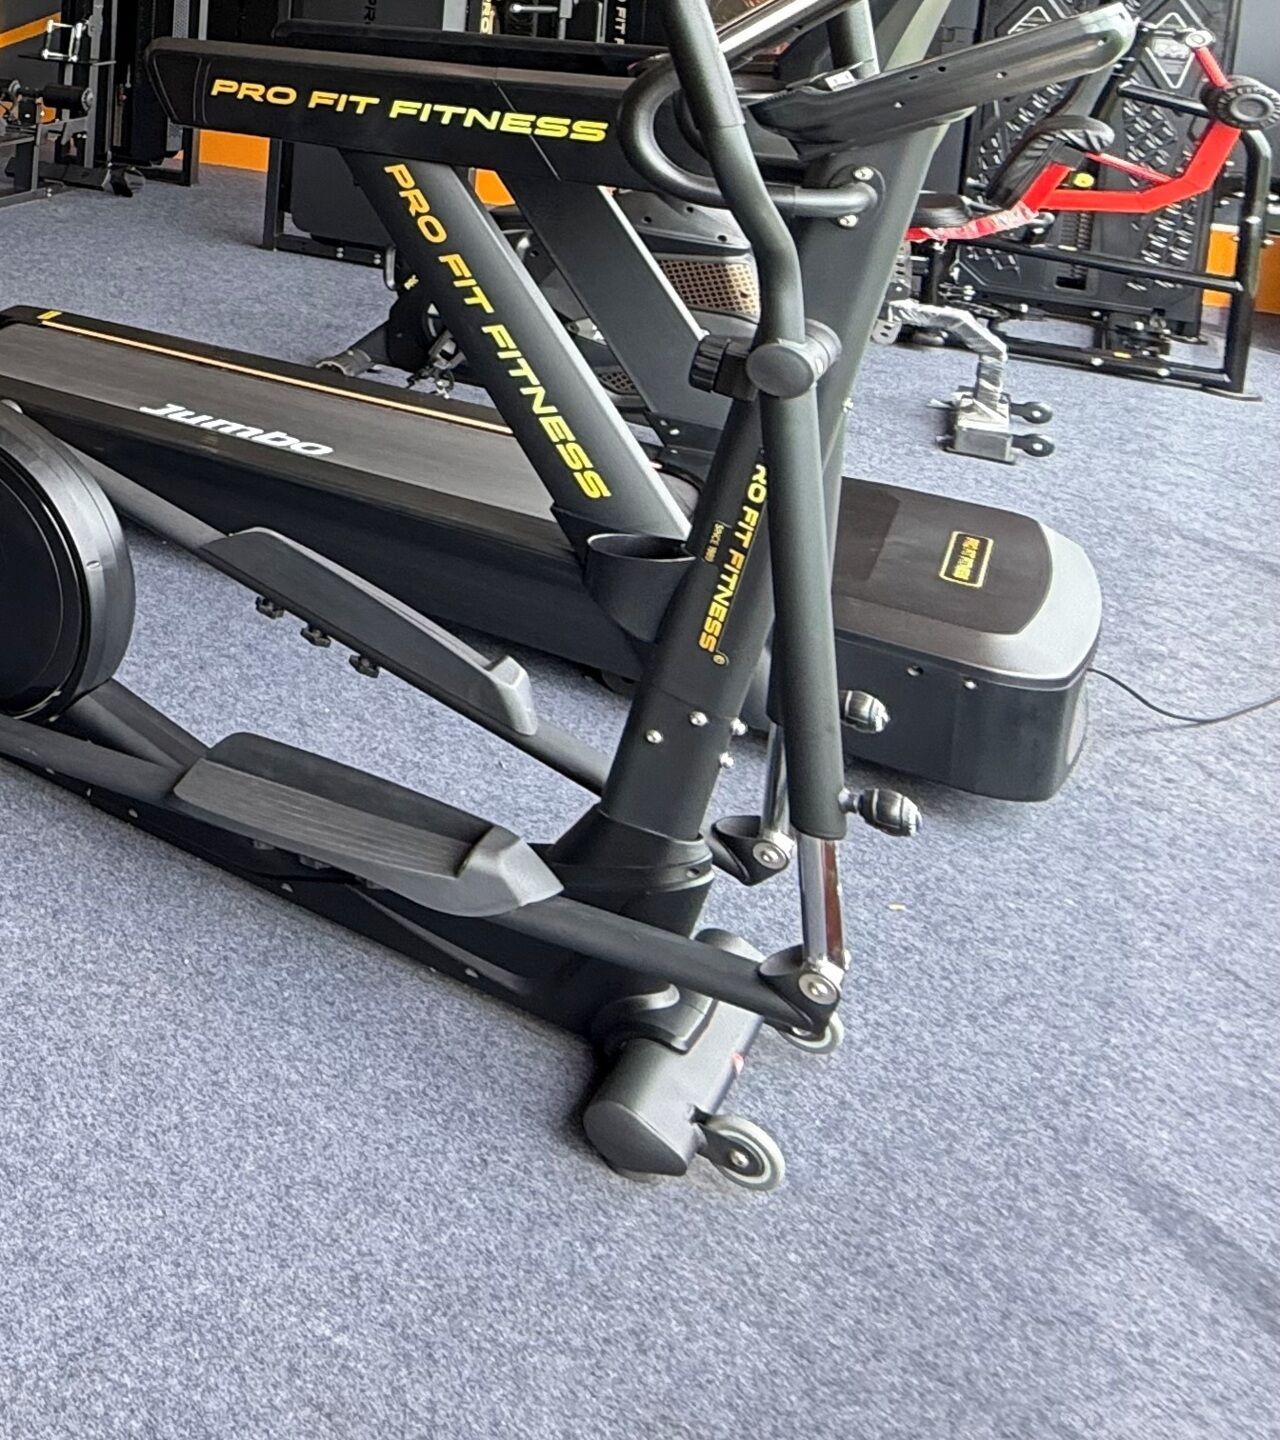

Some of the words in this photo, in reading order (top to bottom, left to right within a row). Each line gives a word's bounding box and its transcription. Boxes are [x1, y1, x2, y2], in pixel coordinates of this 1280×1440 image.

[614, 6, 627, 35] FIT
[210, 78, 297, 106] PRO
[307, 90, 380, 115] FIT
[388, 99, 610, 143] FITNESS
[383, 163, 448, 244] PRO
[438, 253, 495, 314] FIT
[480, 324, 613, 499] FITNESS
[139, 403, 335, 455] Jumbo
[747, 464, 767, 504] RO
[734, 505, 760, 549] FIT
[698, 548, 746, 653] FITNESS
